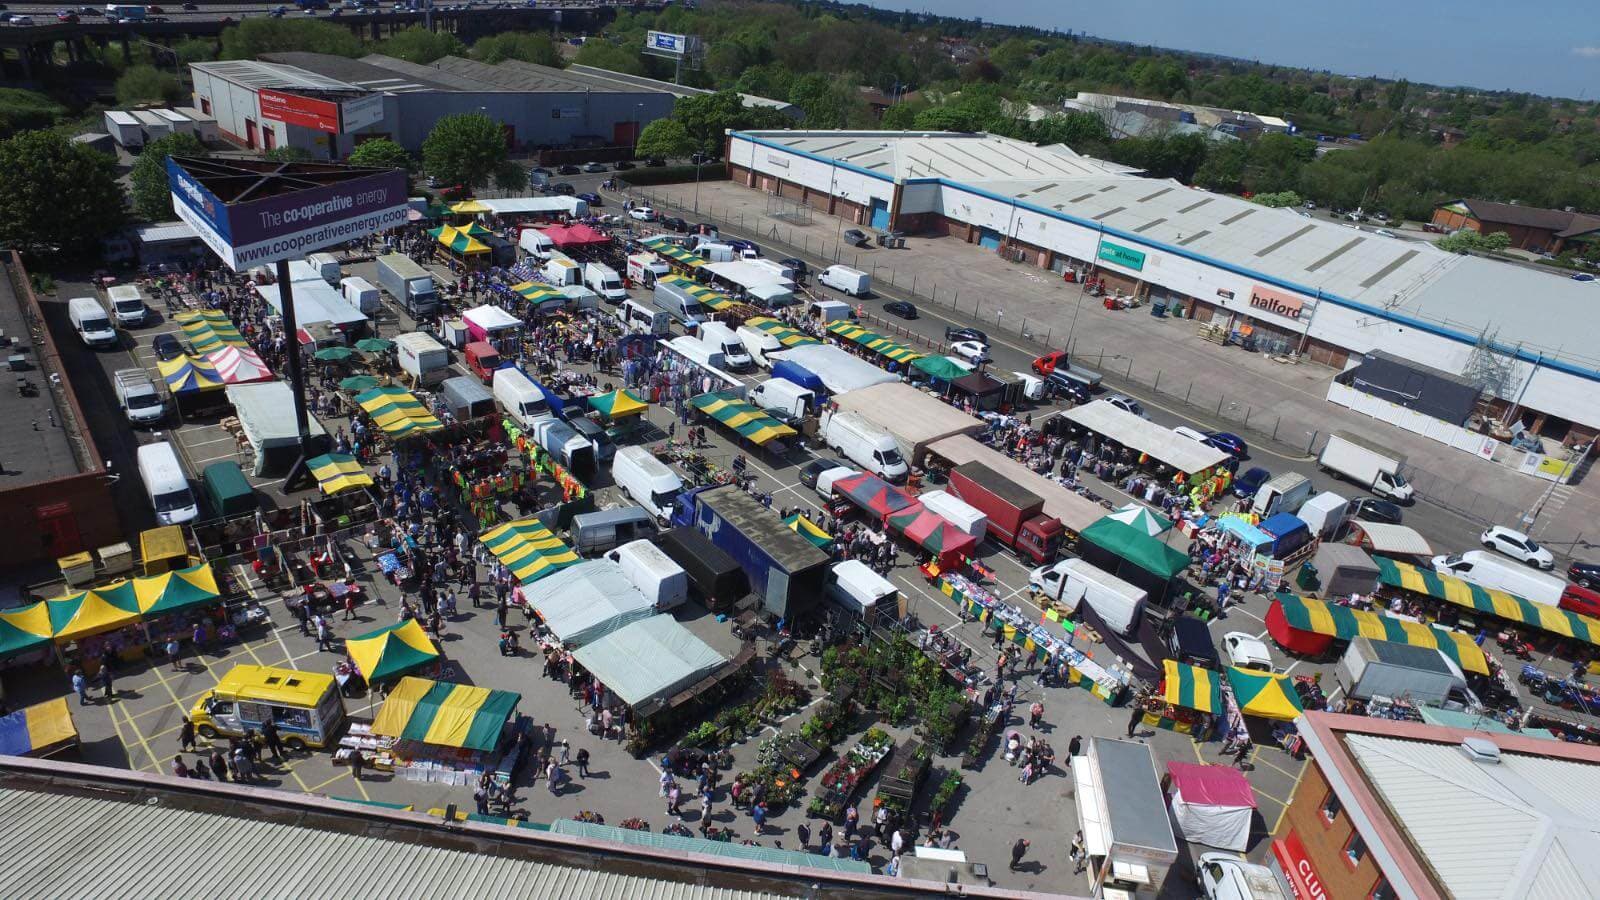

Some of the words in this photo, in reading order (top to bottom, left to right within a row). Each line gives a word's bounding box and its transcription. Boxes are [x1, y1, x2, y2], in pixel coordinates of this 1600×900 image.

[259, 211, 282, 229] The
[283, 194, 353, 224] co-operative
[356, 187, 388, 206] energy
[236, 206, 408, 265] www.cooperativeenergy.coop
[1250, 292, 1302, 319] halford
